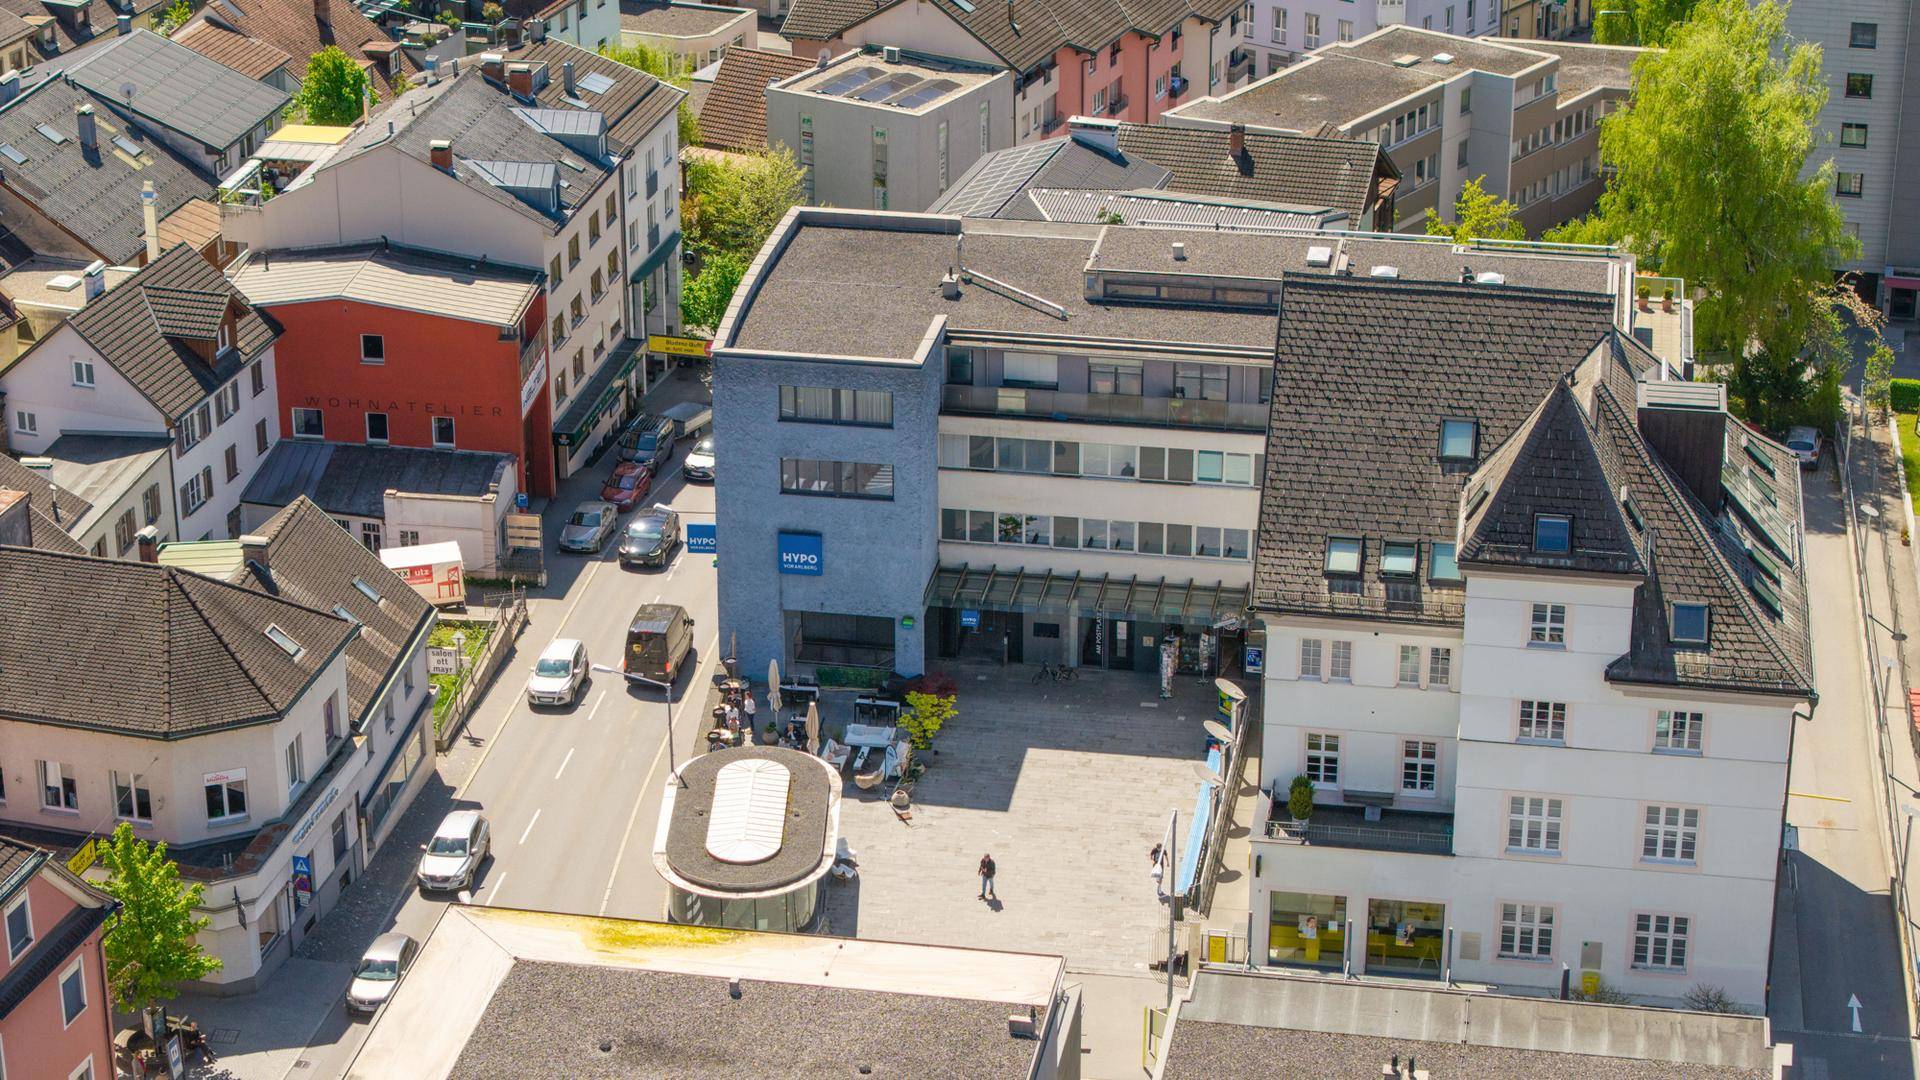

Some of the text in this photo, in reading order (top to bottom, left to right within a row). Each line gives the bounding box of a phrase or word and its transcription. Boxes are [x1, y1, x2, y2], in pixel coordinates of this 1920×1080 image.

[304, 396, 502, 417] WOHNATELIER
[690, 537, 716, 545] HYPO
[783, 552, 817, 564] HYPO
